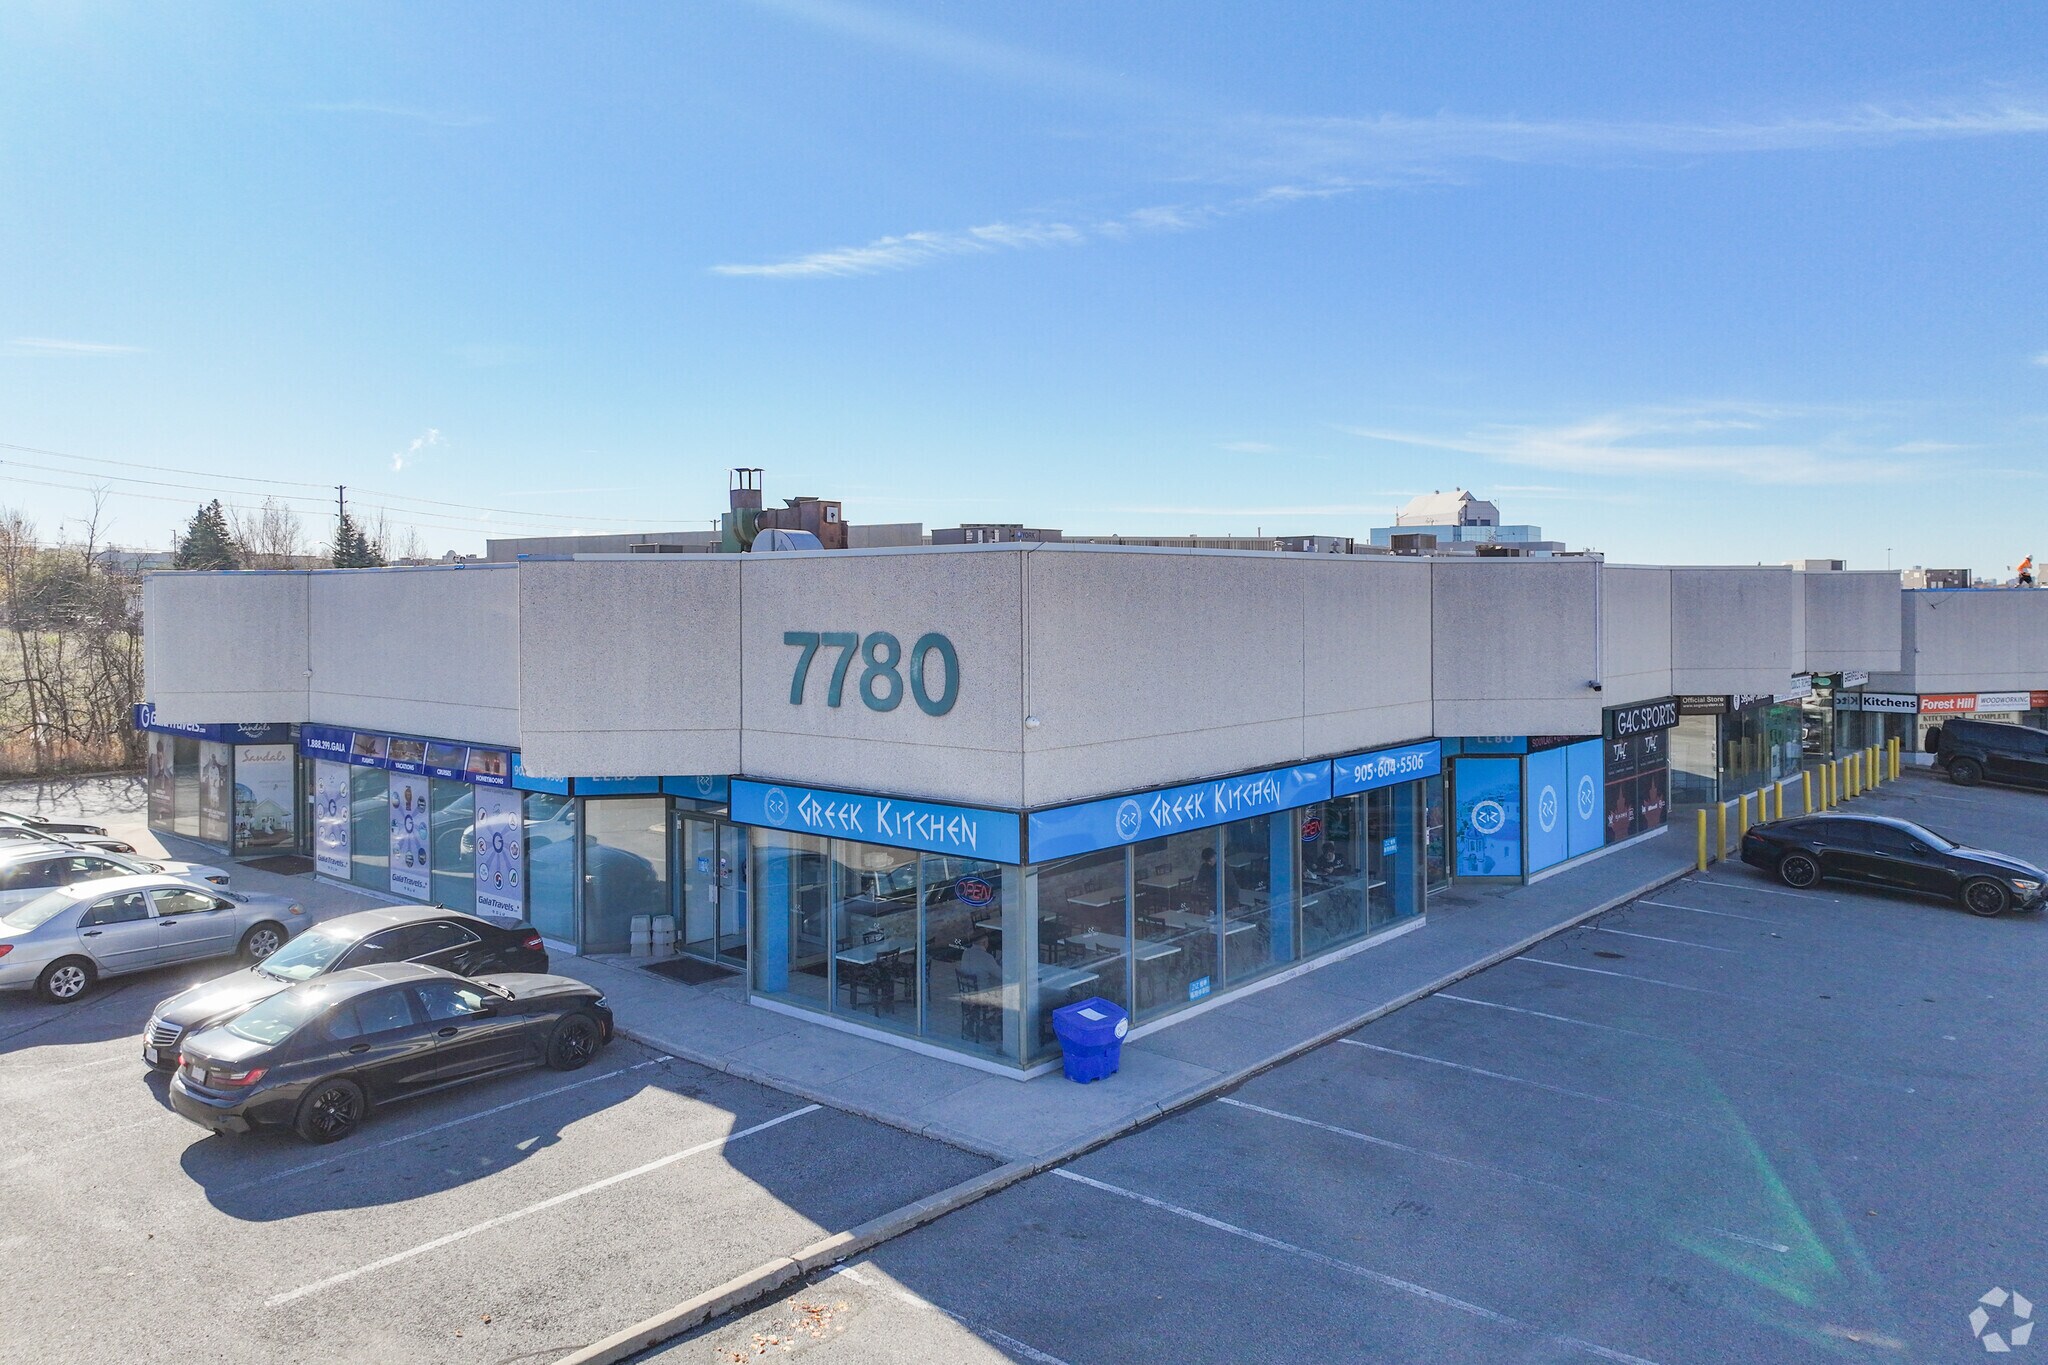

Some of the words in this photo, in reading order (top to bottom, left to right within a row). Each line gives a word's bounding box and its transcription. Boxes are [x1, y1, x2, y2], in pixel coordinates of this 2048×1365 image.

[783, 631, 960, 717] 7780
[1863, 696, 1917, 708] Kitchens
[1920, 699, 1954, 710] Forest
[1956, 697, 1975, 709] Hill
[1980, 696, 2029, 704] WOODWORKING
[1641, 702, 1676, 730] SPORTS
[241, 748, 286, 763] Sandals
[1149, 788, 1205, 830] GREEK
[1213, 780, 1281, 811] KITCHEN
[797, 792, 864, 834] GREEK
[876, 800, 978, 852] KITCHEN
[957, 881, 993, 900] OPEN
